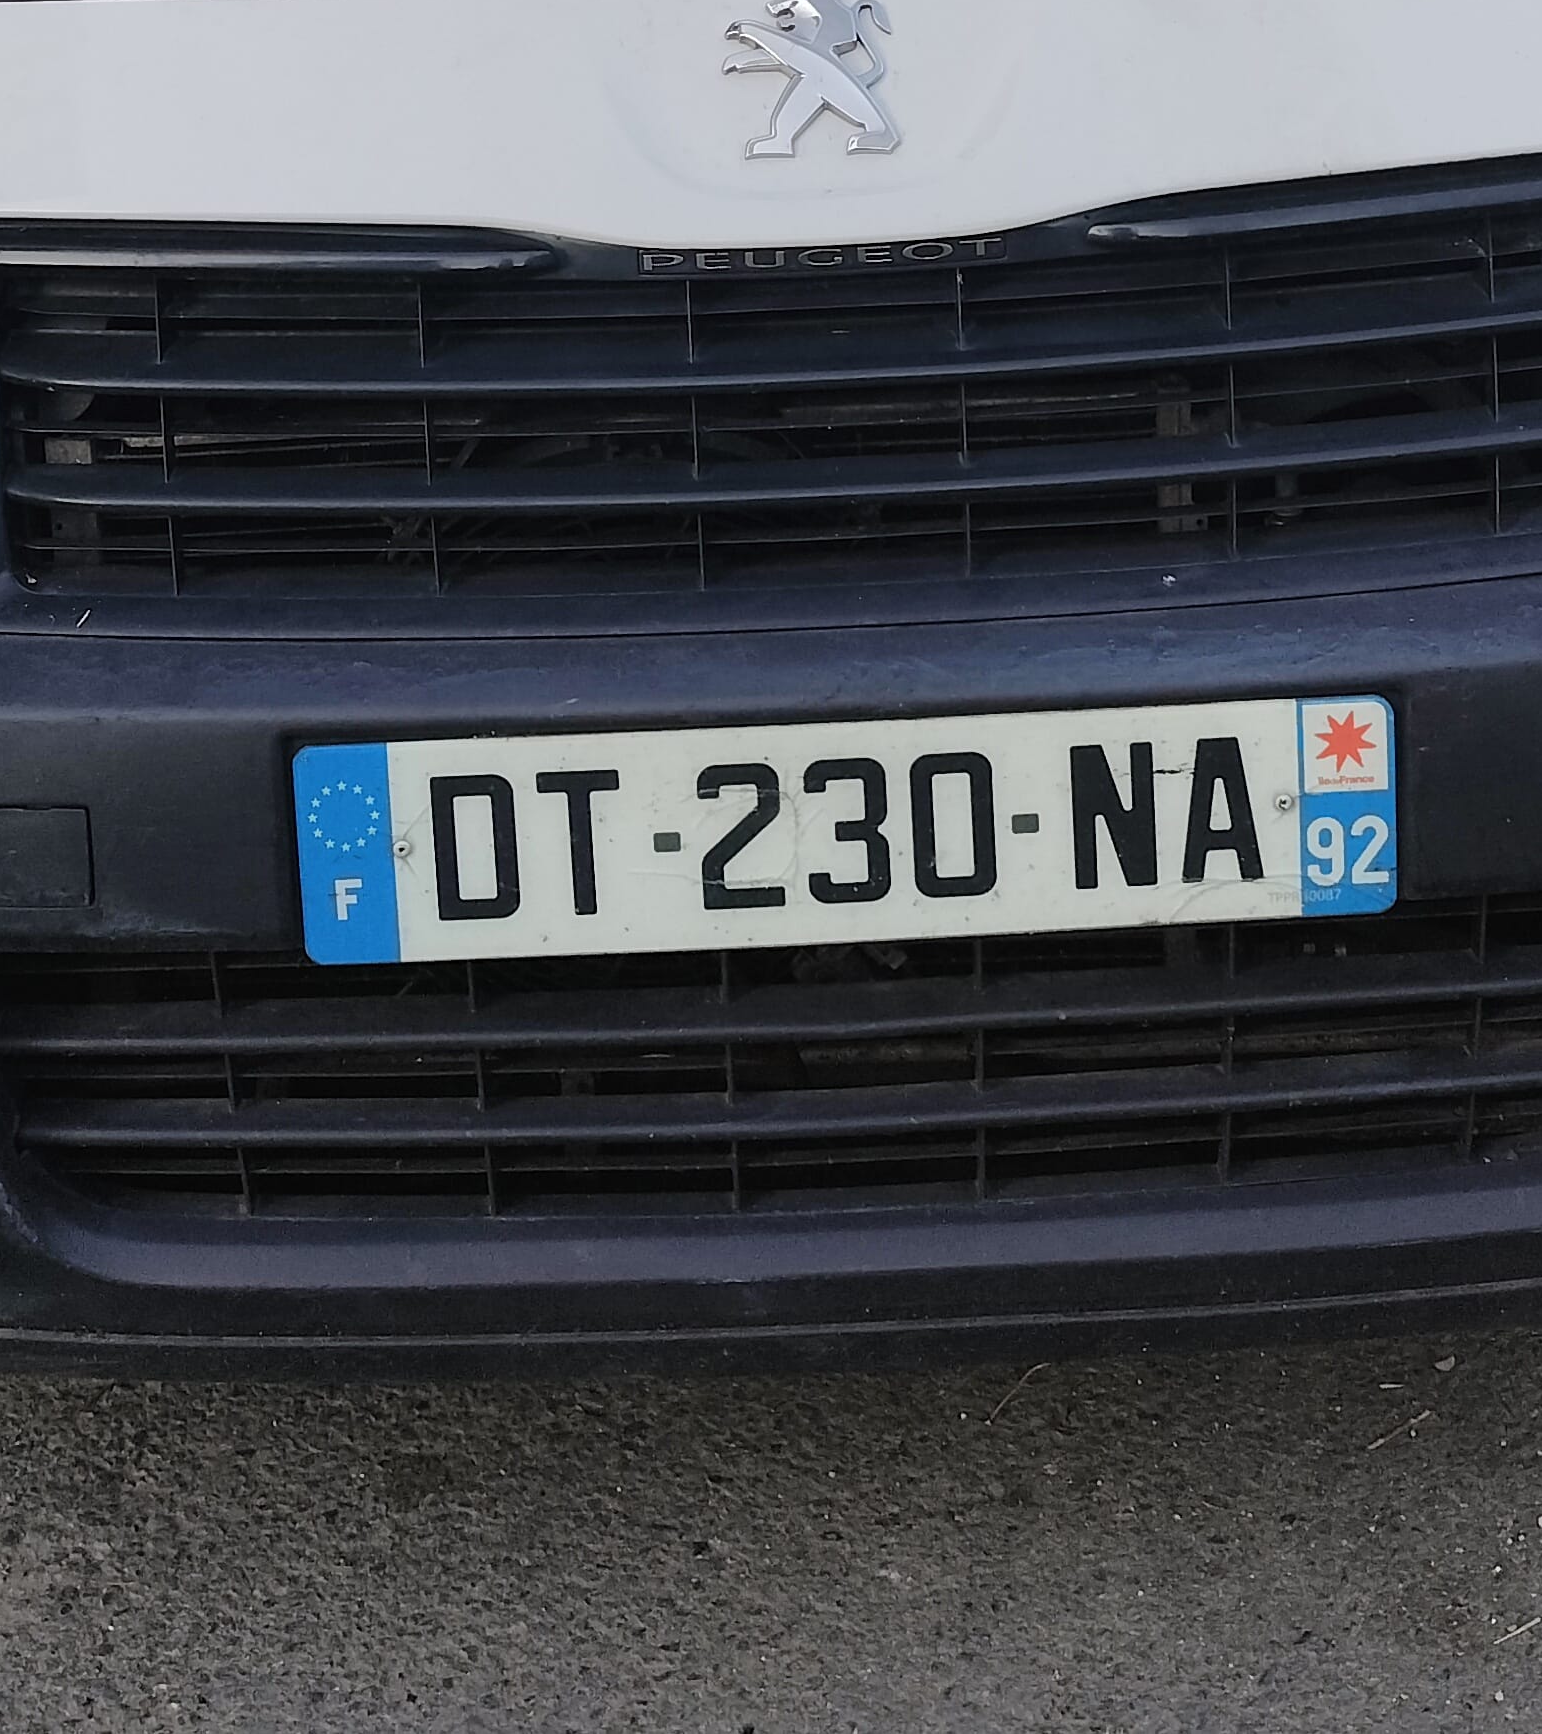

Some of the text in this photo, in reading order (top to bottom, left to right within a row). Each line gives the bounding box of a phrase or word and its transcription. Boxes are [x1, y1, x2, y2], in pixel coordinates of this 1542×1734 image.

[641, 237, 1002, 271] PEUGEOT
[430, 737, 1265, 922] DT-230-NA
[1306, 815, 1390, 886] 92
[335, 879, 362, 920] F
